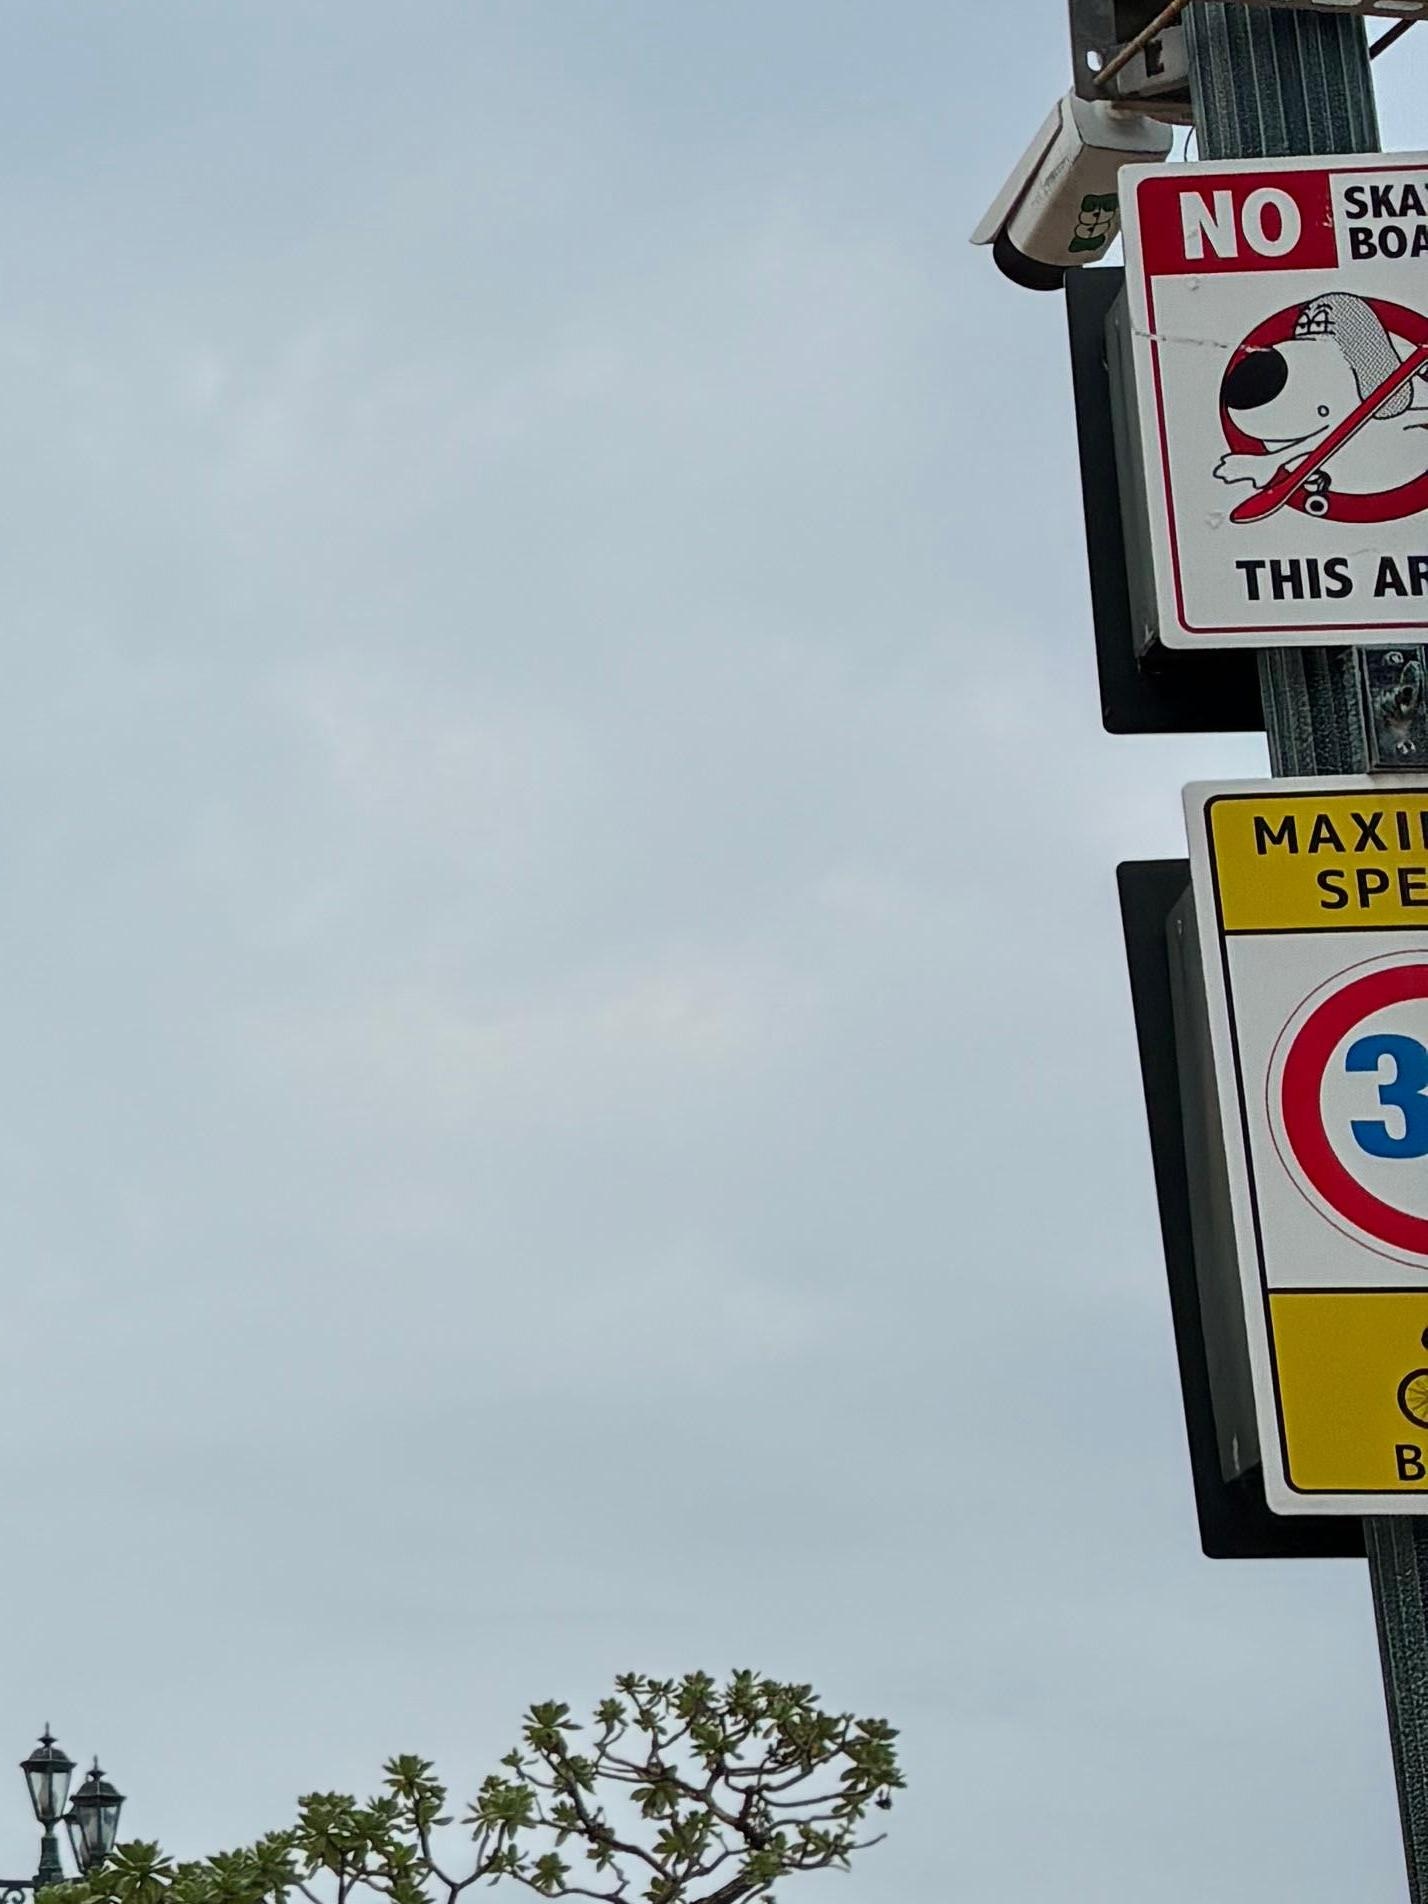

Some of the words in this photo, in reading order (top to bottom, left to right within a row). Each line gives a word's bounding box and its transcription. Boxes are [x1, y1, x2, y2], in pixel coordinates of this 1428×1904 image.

[1179, 186, 1302, 260] NO
[1344, 183, 1428, 220] SKA
[1235, 557, 1353, 600] THIS
[1253, 809, 1428, 856] MAXI
[1345, 1033, 1428, 1160] 3
